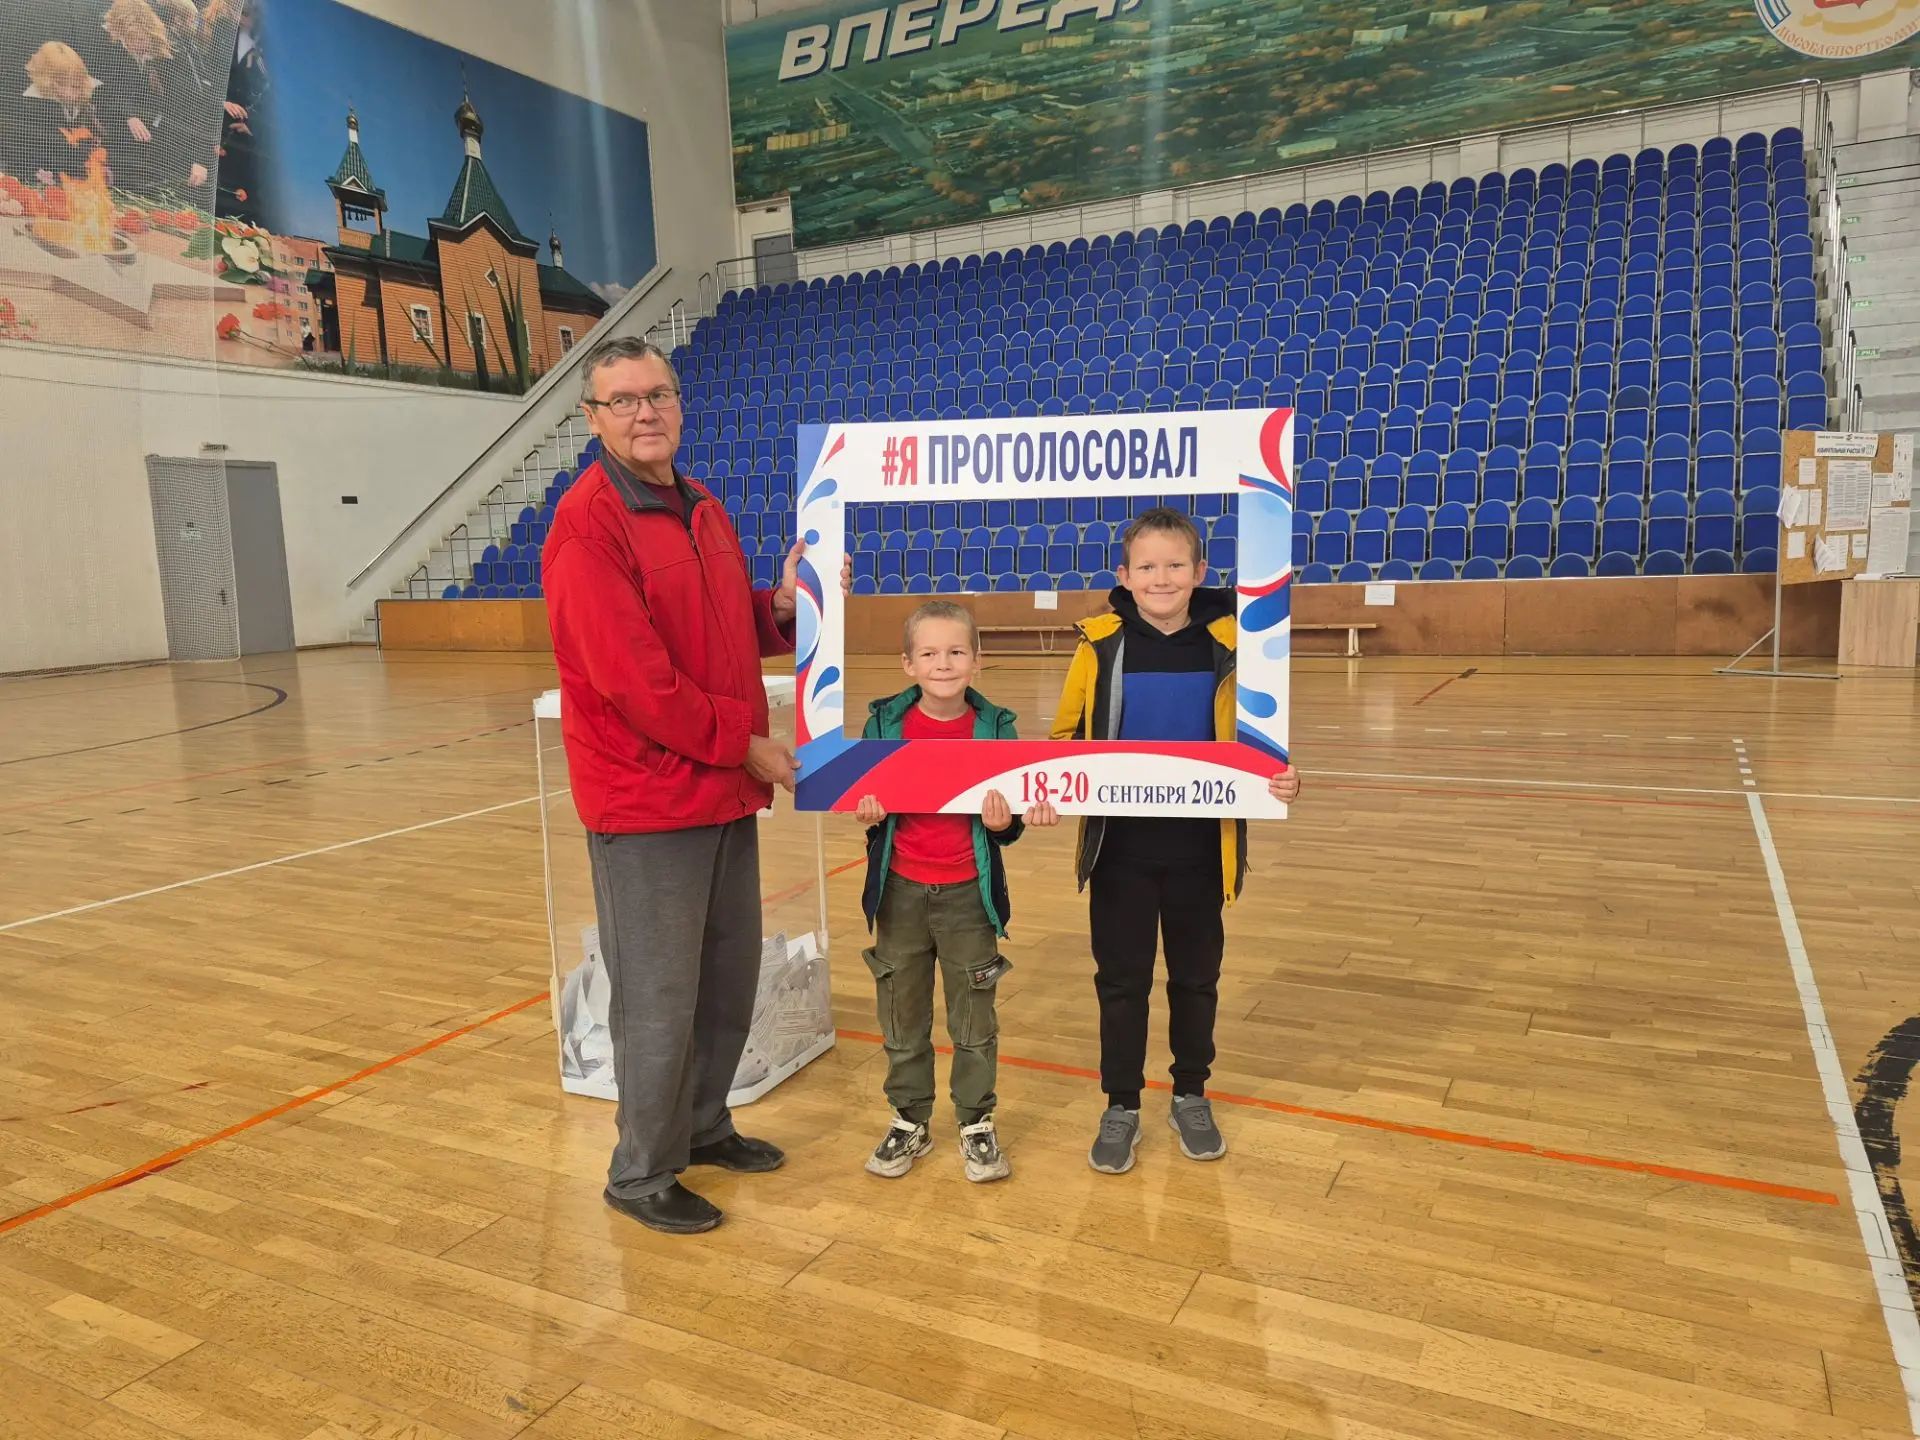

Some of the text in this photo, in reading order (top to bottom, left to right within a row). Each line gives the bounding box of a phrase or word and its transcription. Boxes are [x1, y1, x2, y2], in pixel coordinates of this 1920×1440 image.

[881, 426, 1198, 486] #Я ПРОГОЛОСОВАЛ
[1021, 770, 1236, 805] 18-20 СЕНТЯБРЯ 2026
